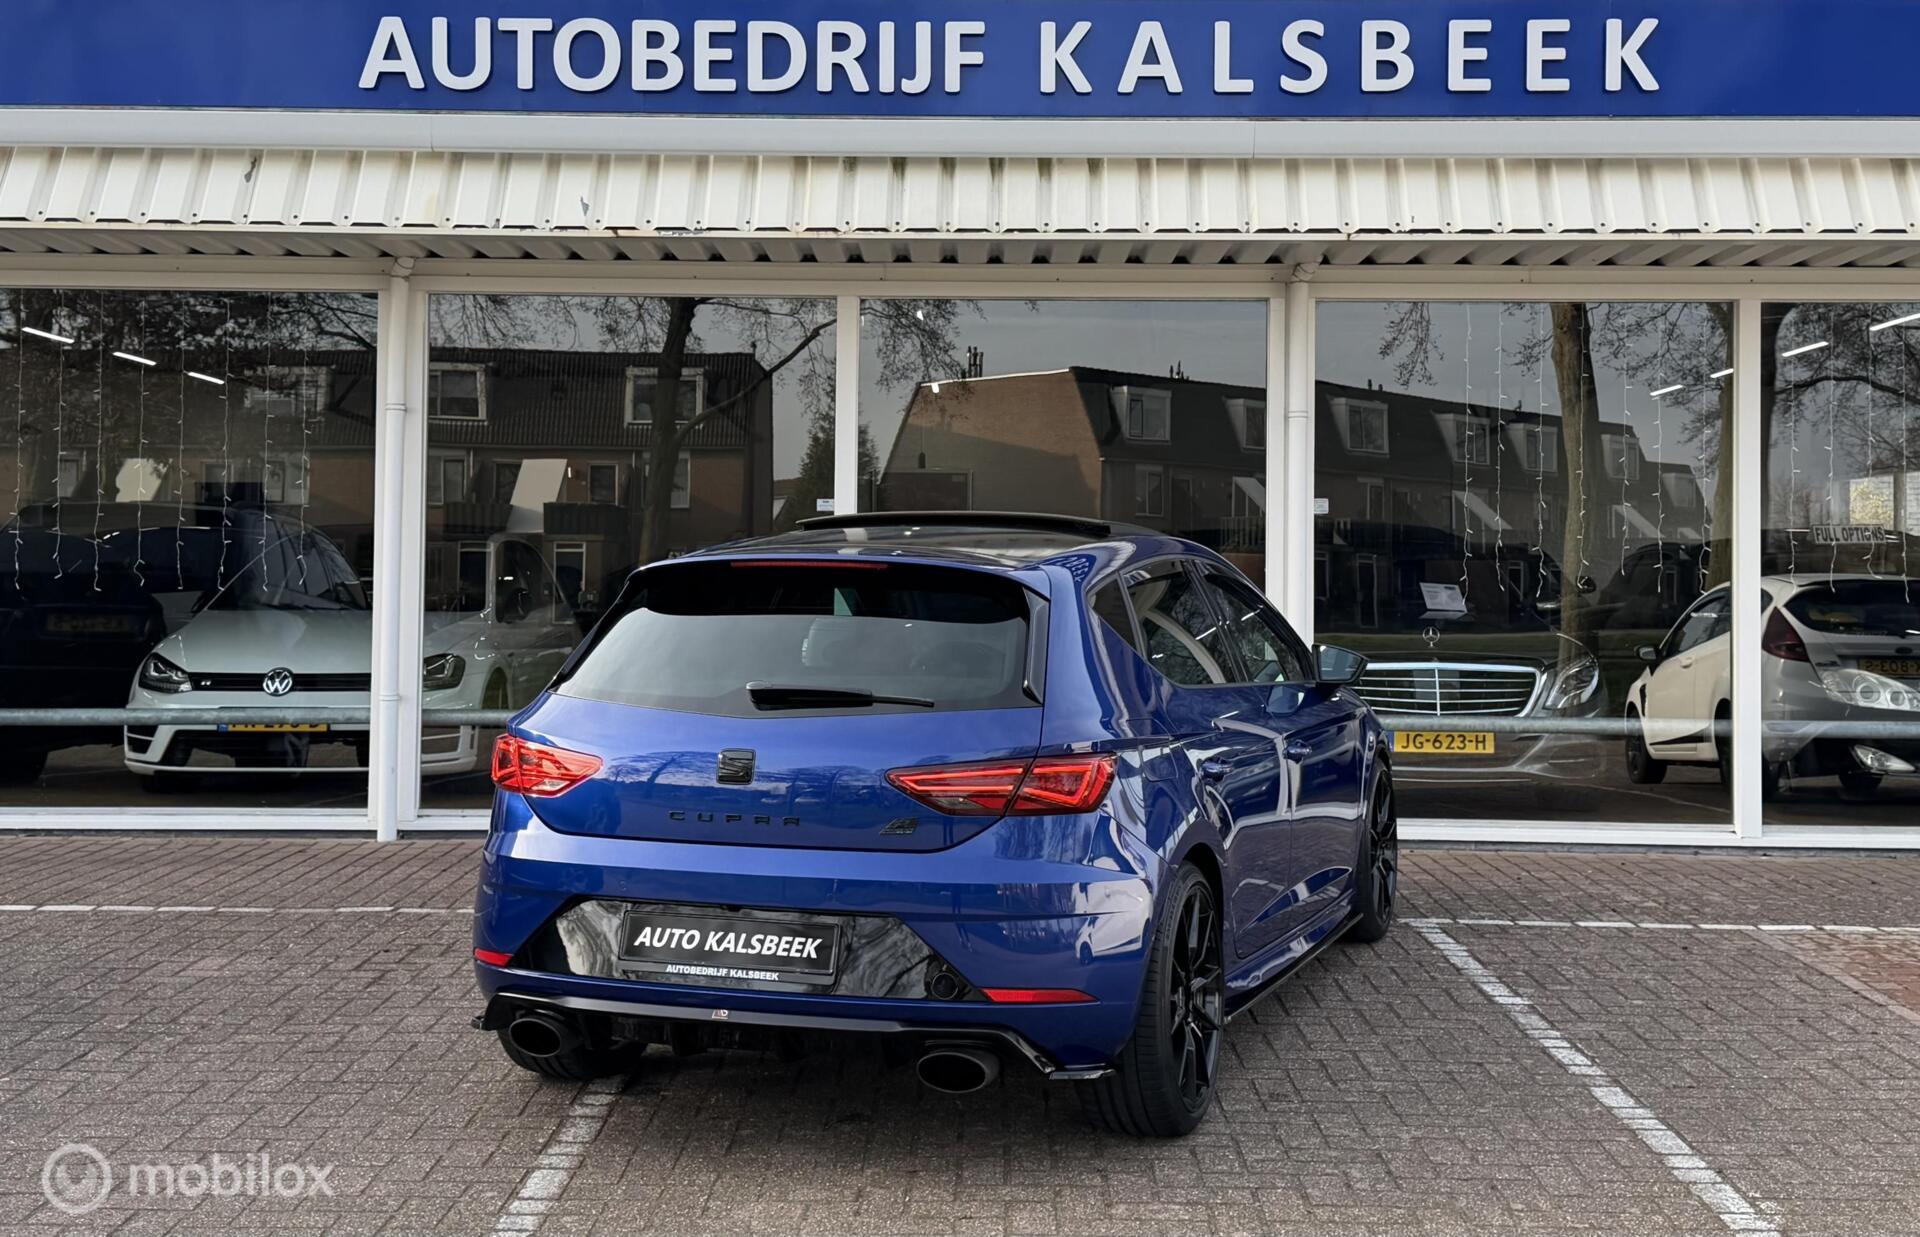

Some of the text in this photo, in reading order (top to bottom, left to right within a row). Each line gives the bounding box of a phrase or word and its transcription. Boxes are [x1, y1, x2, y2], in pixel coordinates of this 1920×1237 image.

[359, 16, 1660, 94] AUTOBEDRIJF KALSBEEK
[1815, 526, 1885, 542] FULL OPTIONS
[1401, 733, 1487, 750] JG-623-H
[669, 810, 800, 826] CUPRA
[633, 926, 823, 959] AUTO KALSBEEK
[666, 964, 779, 981] AUTOBEDRIJF KALSBEEK
